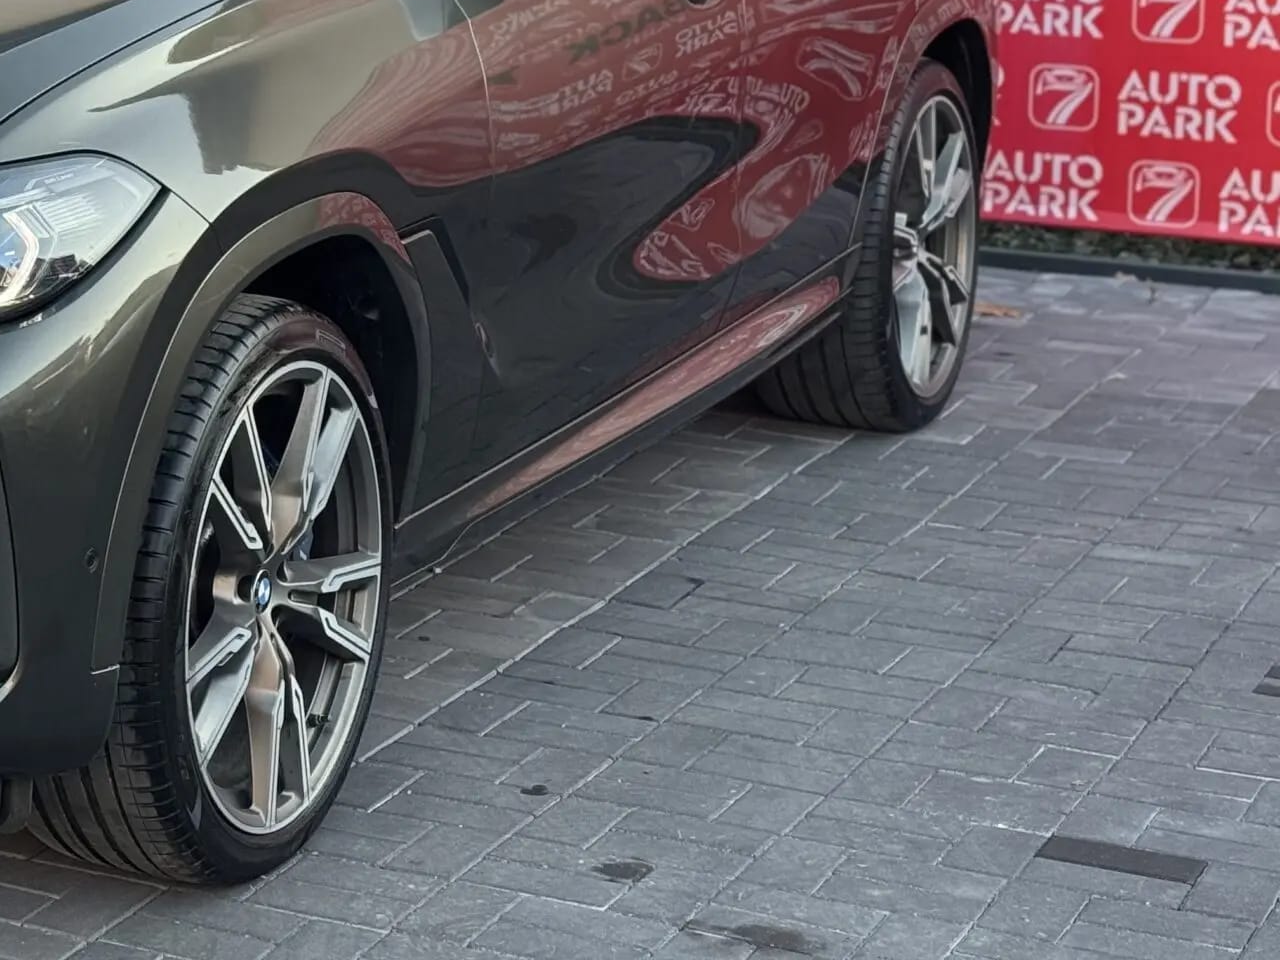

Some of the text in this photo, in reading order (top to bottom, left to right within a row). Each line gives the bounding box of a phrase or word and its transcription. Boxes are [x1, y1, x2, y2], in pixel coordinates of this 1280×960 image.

[996, 3, 1103, 38] PARK
[1118, 70, 1241, 108] AUTO
[1118, 105, 1238, 142] PARK
[984, 151, 1103, 188] AUTO
[983, 184, 1099, 222] PARK
